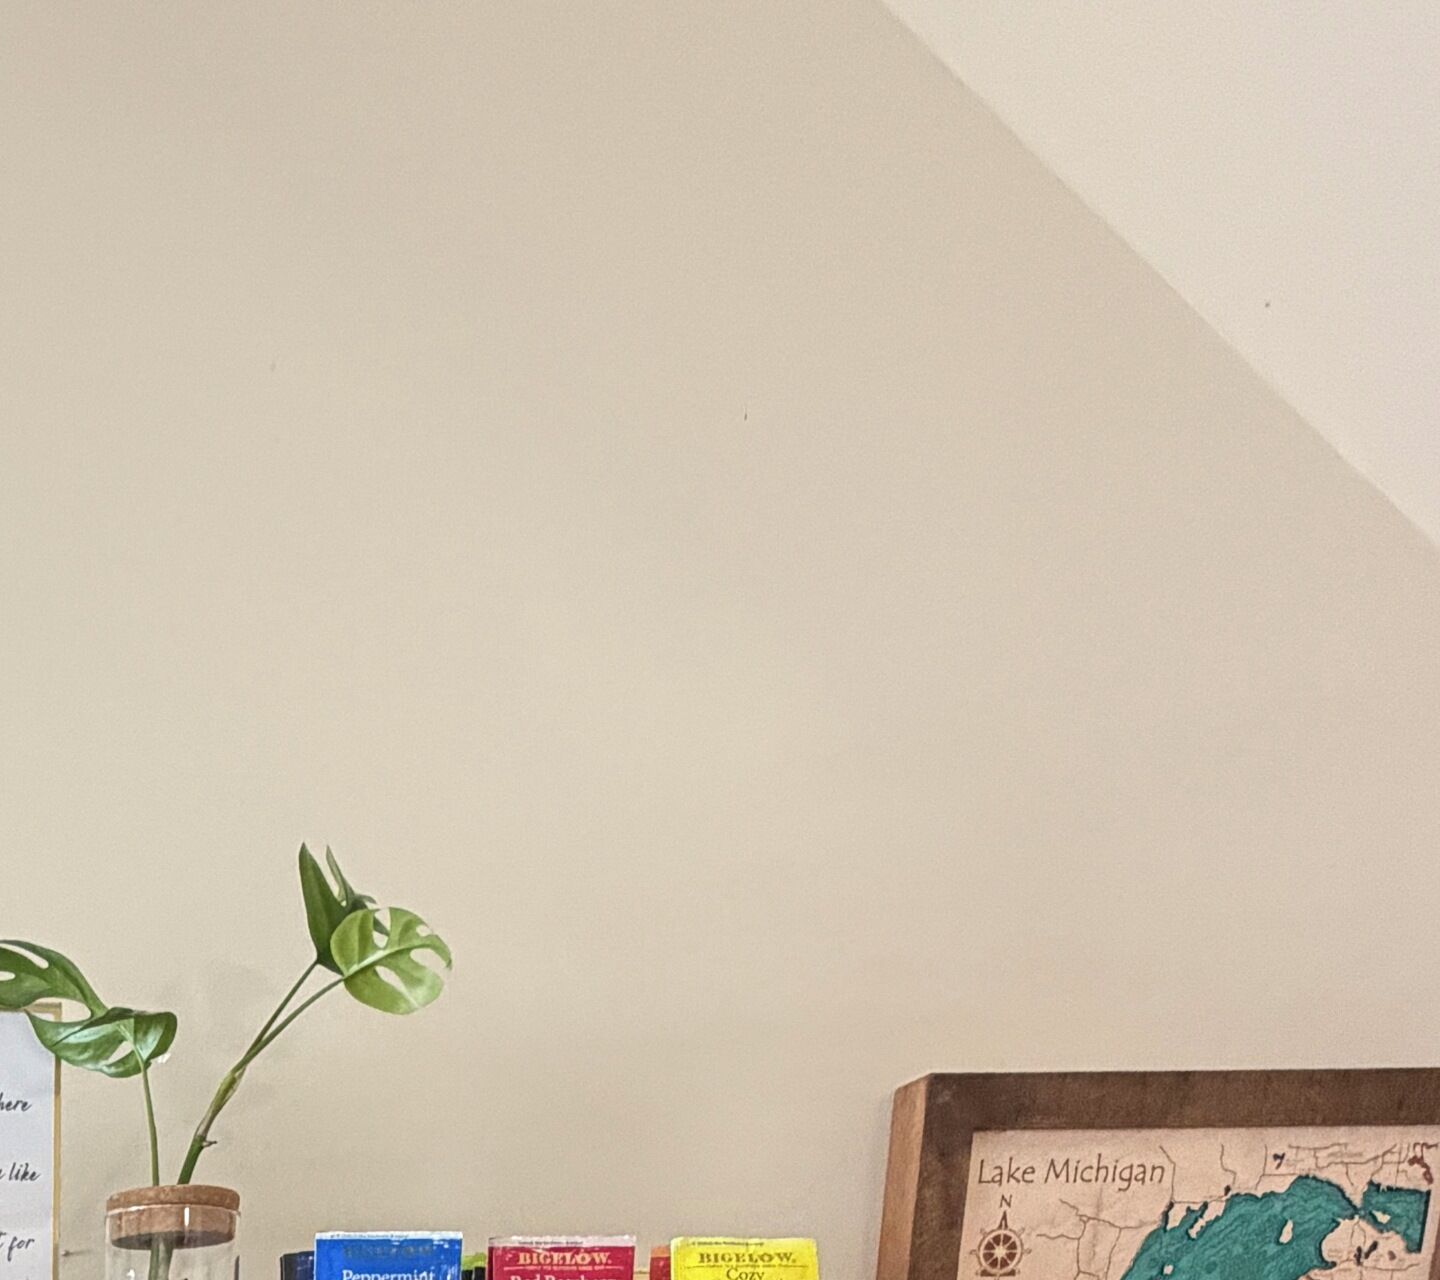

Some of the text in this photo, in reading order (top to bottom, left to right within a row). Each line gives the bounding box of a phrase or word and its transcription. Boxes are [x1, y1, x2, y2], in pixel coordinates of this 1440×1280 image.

[8, 1161, 41, 1183] like
[978, 1153, 1165, 1193] Lake Michigan
[999, 1194, 1013, 1209] N
[5, 1236, 35, 1262] for
